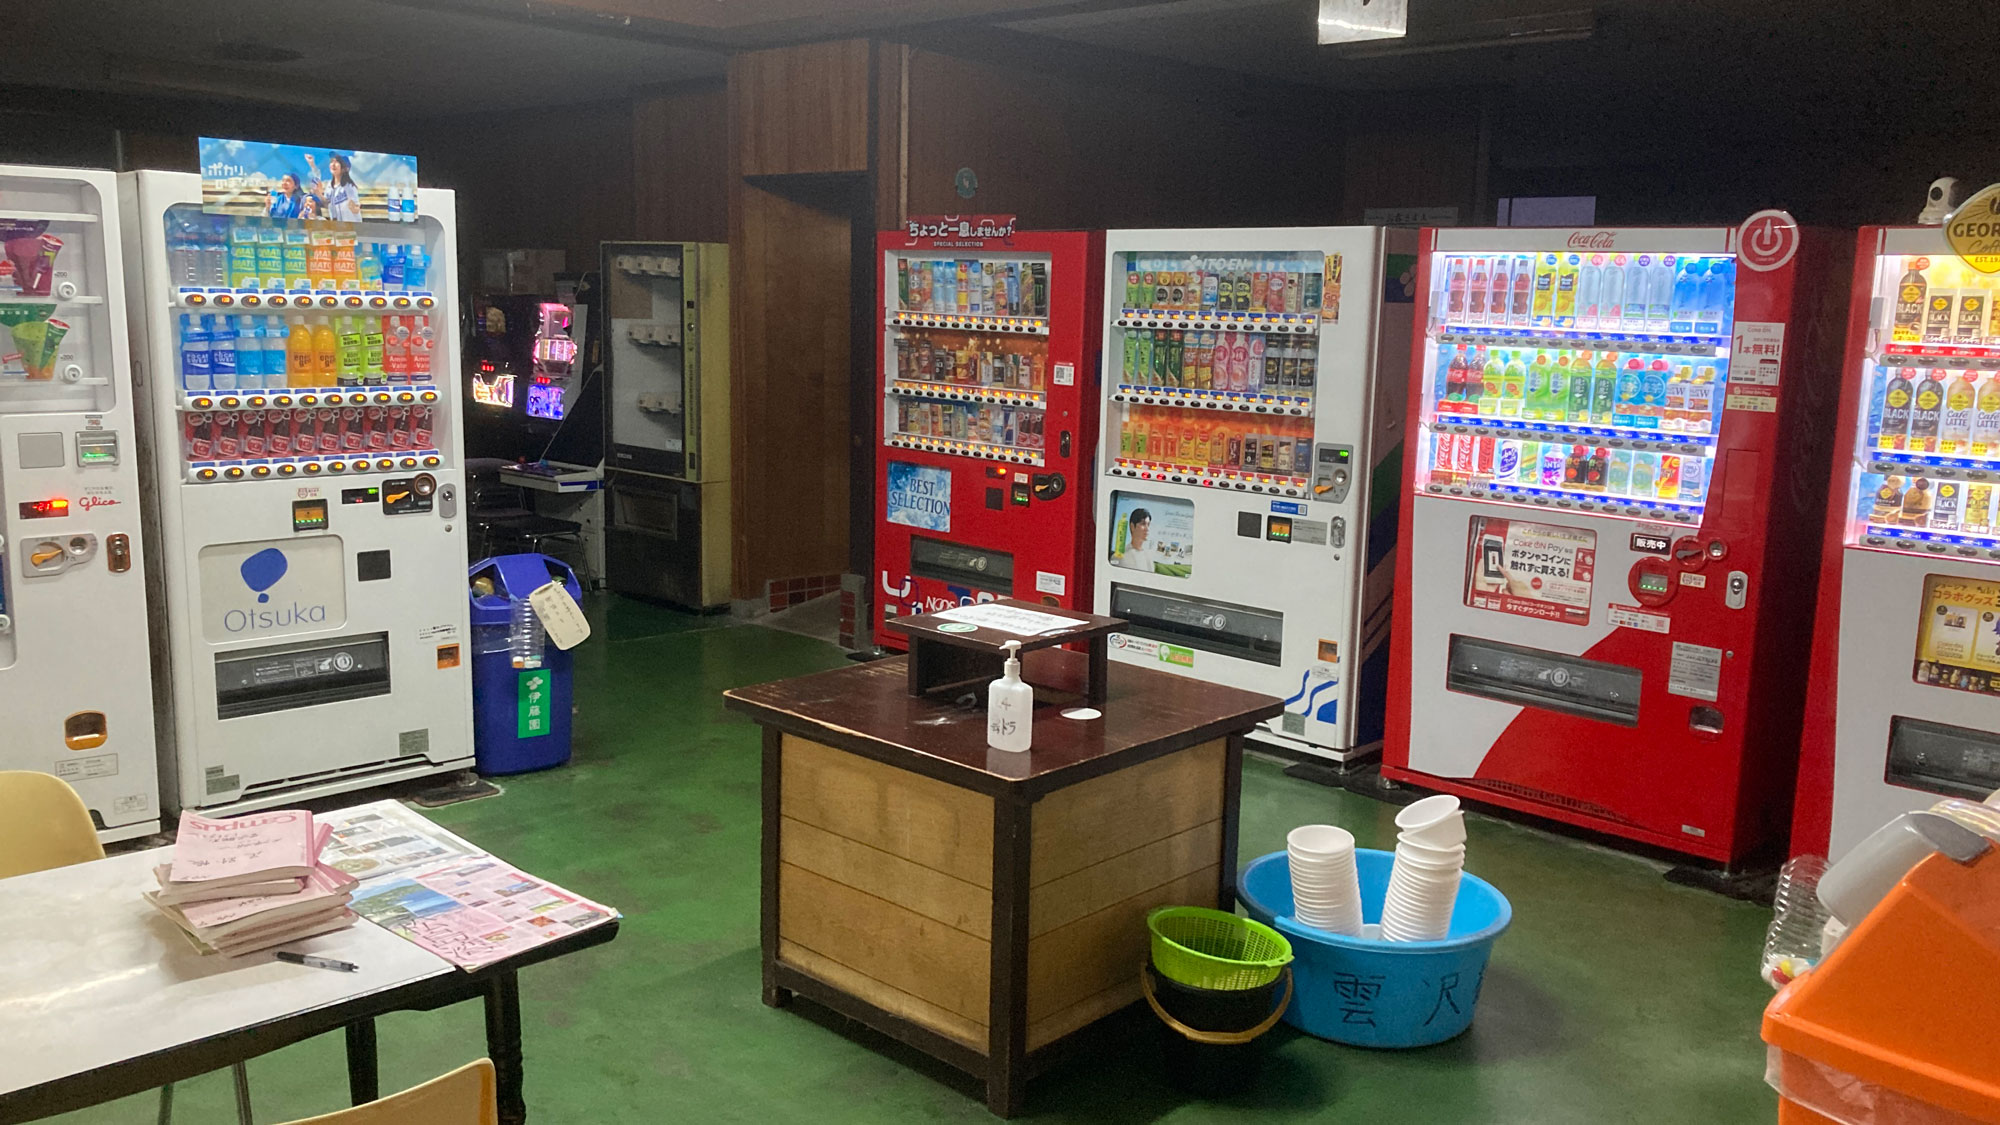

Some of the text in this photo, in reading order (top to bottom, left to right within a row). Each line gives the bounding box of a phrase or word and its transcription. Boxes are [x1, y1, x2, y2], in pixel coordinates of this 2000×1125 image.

[1567, 231, 1618, 248] Coca-Cola
[1945, 418, 1968, 427] LATTE
[909, 478, 936, 496] BEST
[79, 496, 121, 511] Glico
[891, 492, 950, 516] SELECTION
[1513, 538, 1532, 548] Coke
[1547, 543, 1565, 554] Pay
[1636, 537, 1667, 550] 販売中
[1511, 549, 1571, 566] ボタンやコインに
[1510, 560, 1570, 578] 触れずに買える!
[224, 602, 326, 632] Otsuka
[528, 691, 542, 731] 伊藤園
[190, 814, 298, 833] Campus
[1333, 964, 1488, 1028] 雲沢
